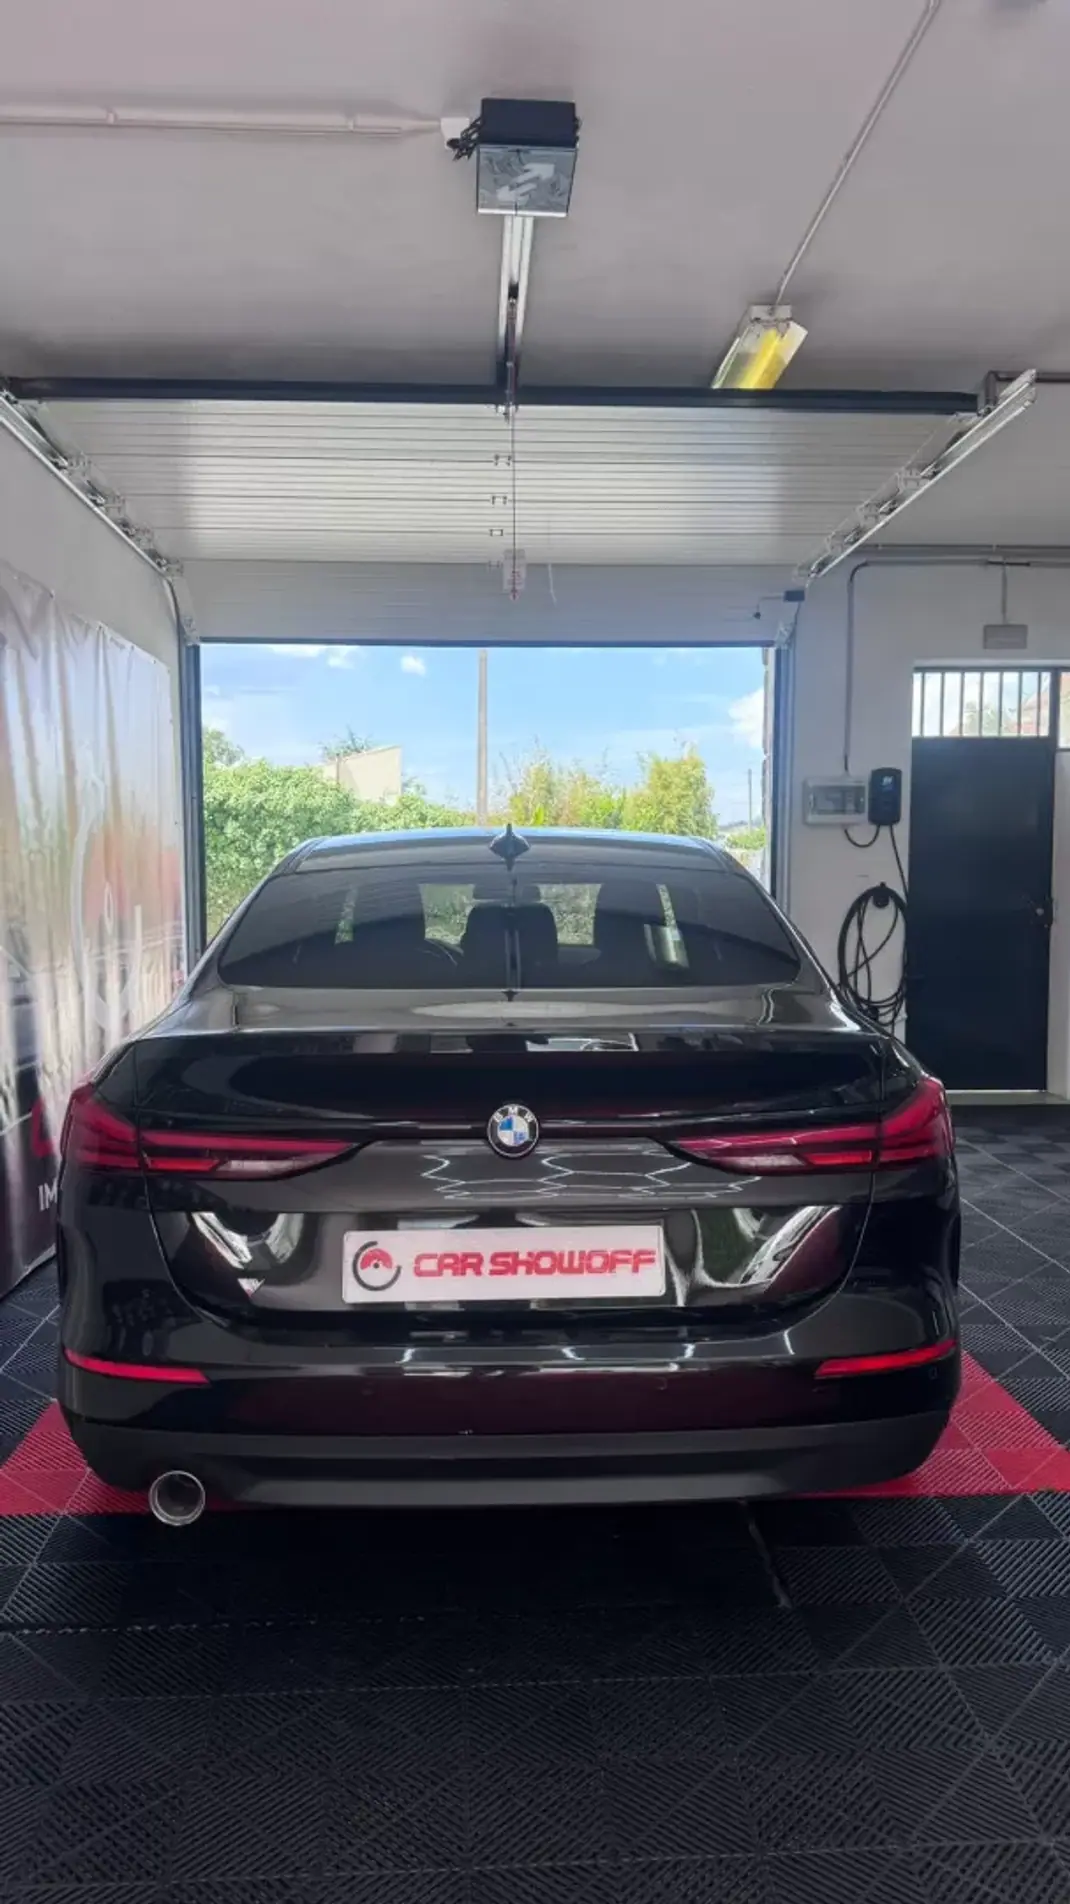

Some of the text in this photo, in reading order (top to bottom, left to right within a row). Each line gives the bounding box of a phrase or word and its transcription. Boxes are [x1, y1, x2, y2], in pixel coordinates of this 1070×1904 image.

[493, 1106, 535, 1122] BMW
[413, 1249, 656, 1277] CAR SHOWOFF
